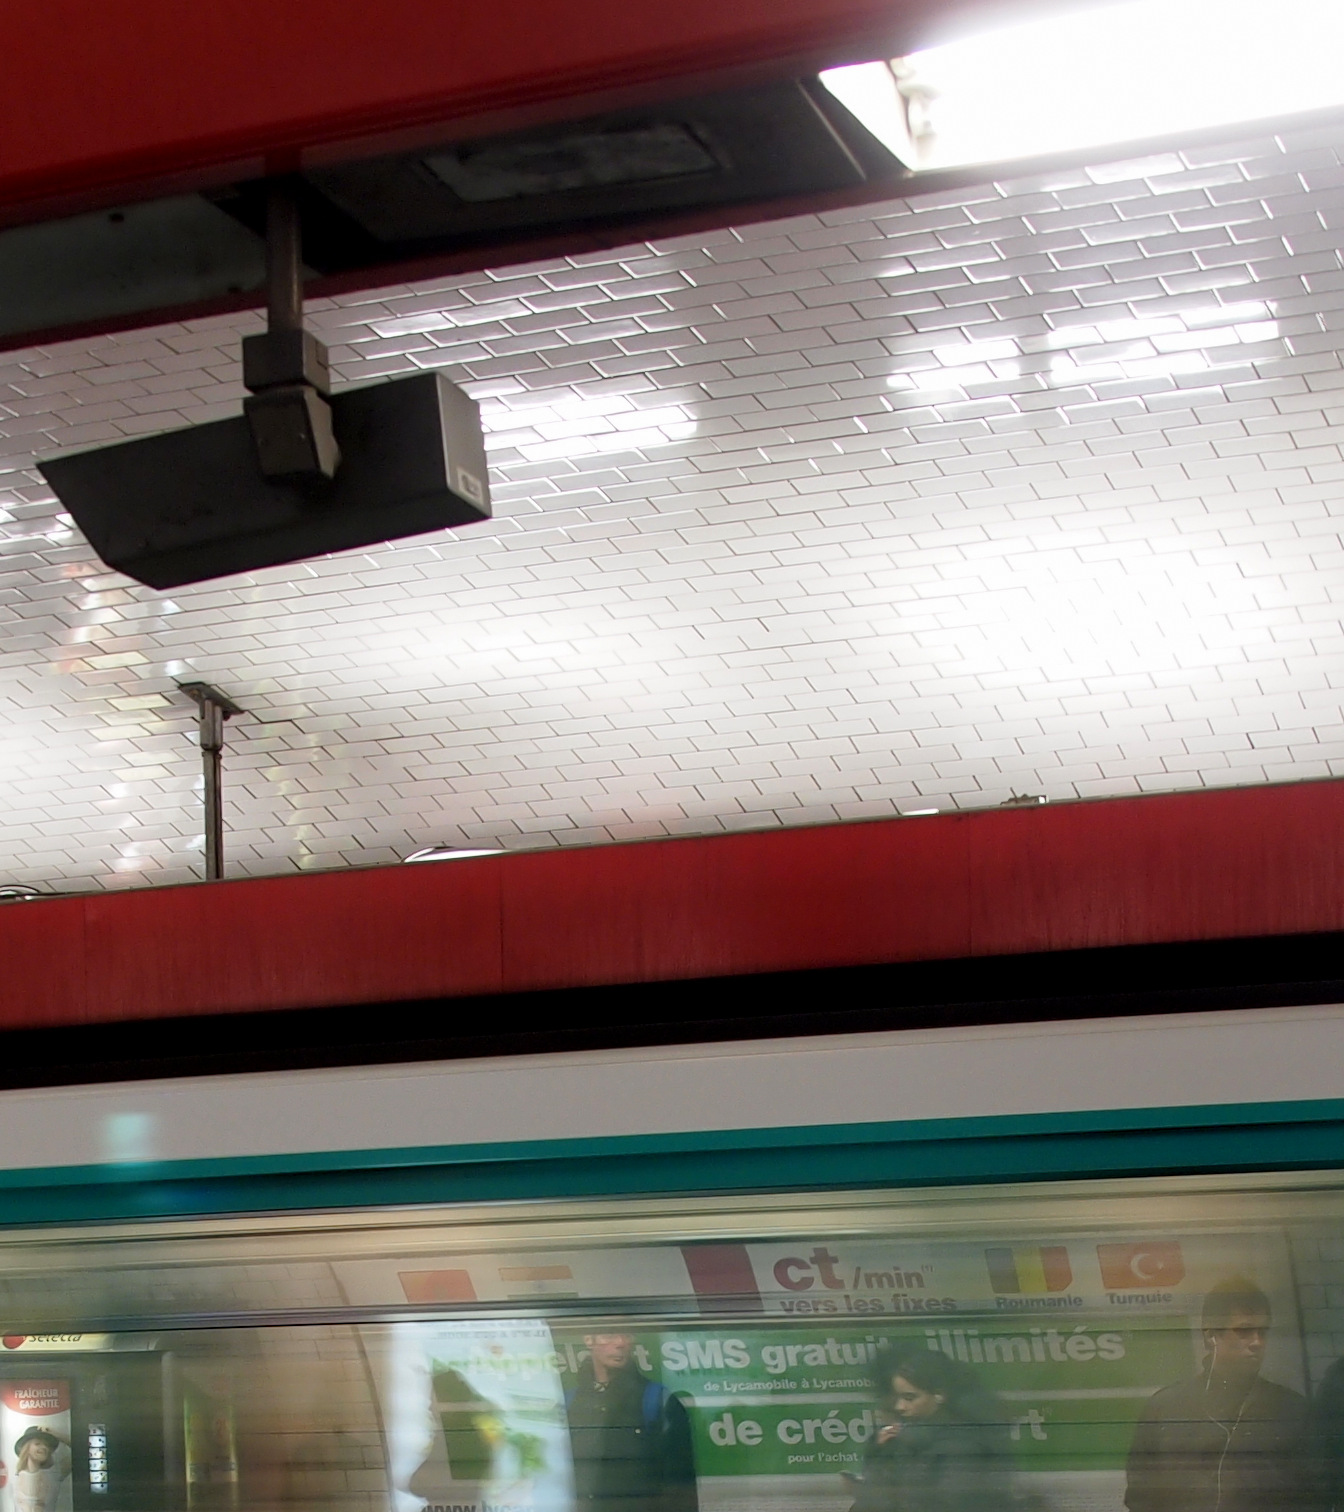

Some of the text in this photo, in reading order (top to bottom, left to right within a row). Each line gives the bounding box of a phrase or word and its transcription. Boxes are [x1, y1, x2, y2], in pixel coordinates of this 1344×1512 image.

[780, 1293, 957, 1314] vers les fixes
[995, 1294, 1084, 1309] Roumanie
[1107, 1290, 1174, 1308] Turquie
[660, 1338, 751, 1371] SMS
[925, 1326, 1126, 1363] illimités
[703, 1377, 875, 1393] de Lycamobile à Lycamob
[19, 1398, 60, 1410] GARANTIE
[709, 1409, 875, 1446] de créd
[787, 1454, 816, 1464] pour
